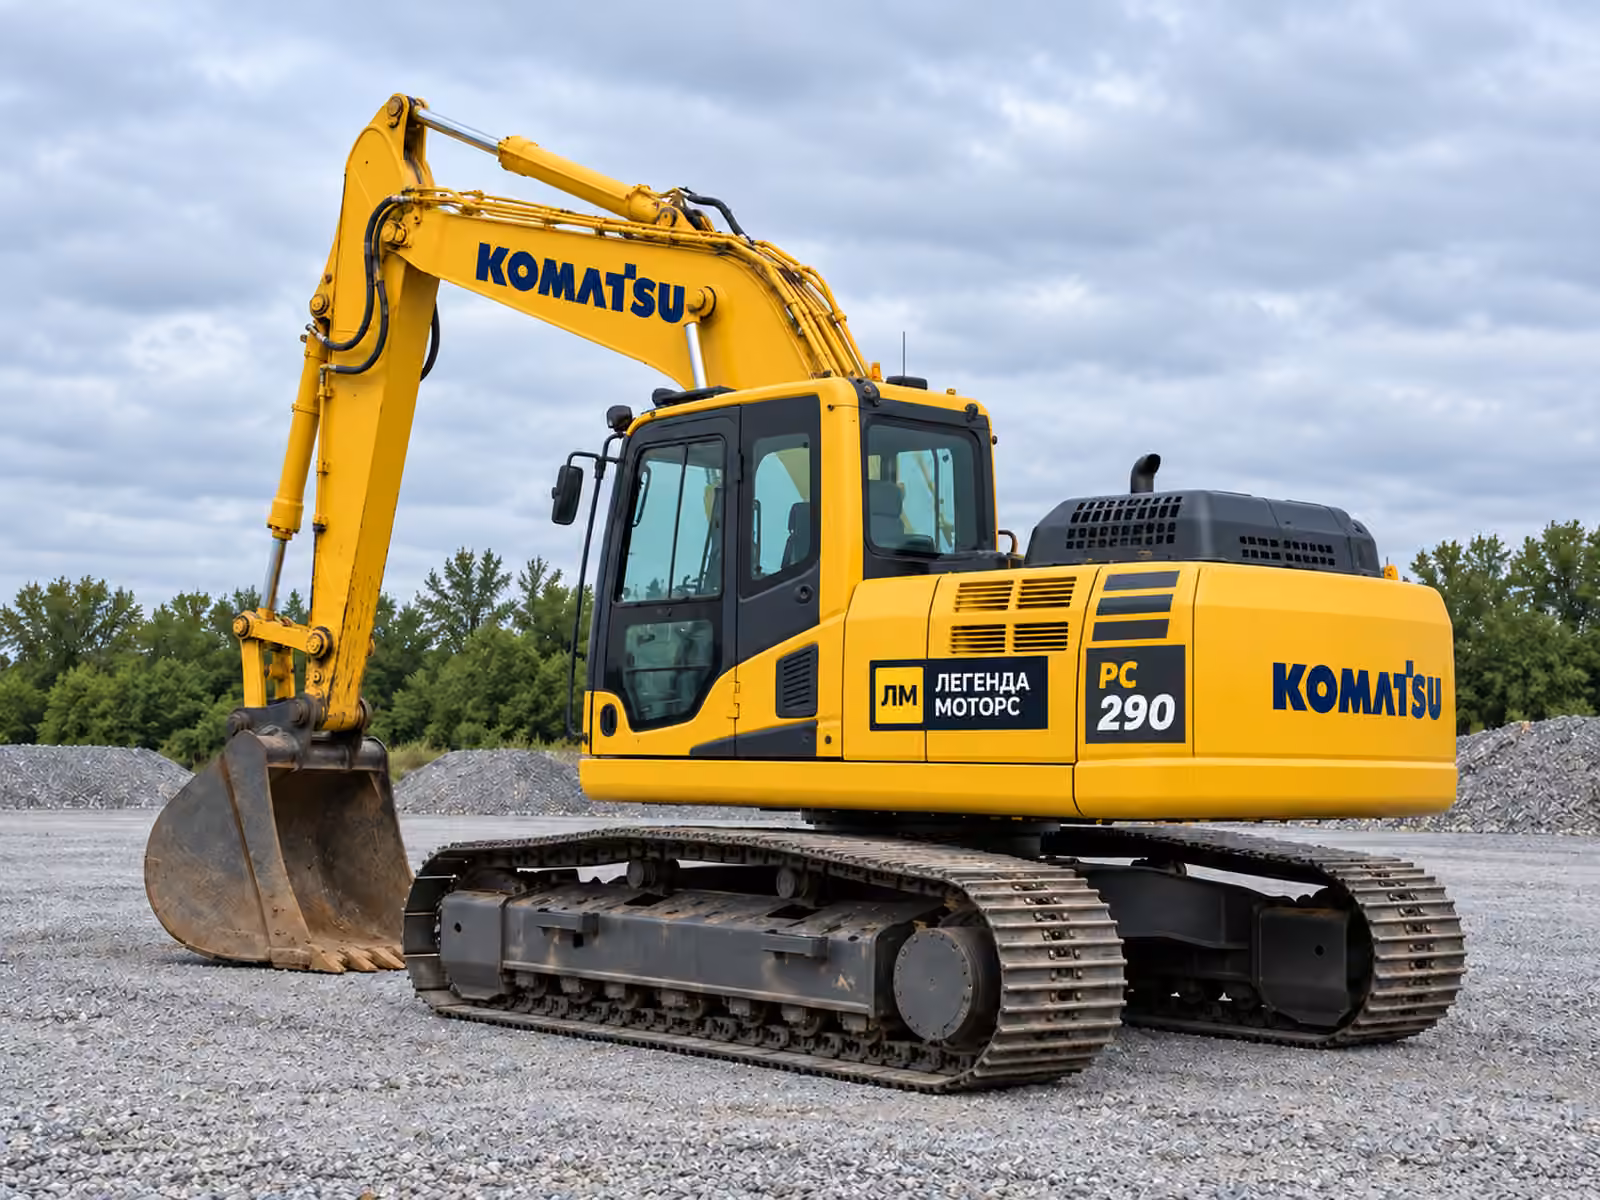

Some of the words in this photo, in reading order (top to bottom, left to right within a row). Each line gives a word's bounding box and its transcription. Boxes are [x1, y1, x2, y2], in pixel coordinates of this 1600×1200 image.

[476, 242, 685, 323] KOMATSU
[935, 672, 1030, 694] ЛЕГЕНДА
[1099, 661, 1138, 689] PC
[881, 684, 918, 707] ЛМ
[1273, 660, 1442, 721] KOMATSU
[935, 697, 1020, 717] МОТОРС
[1097, 694, 1176, 731] 290
